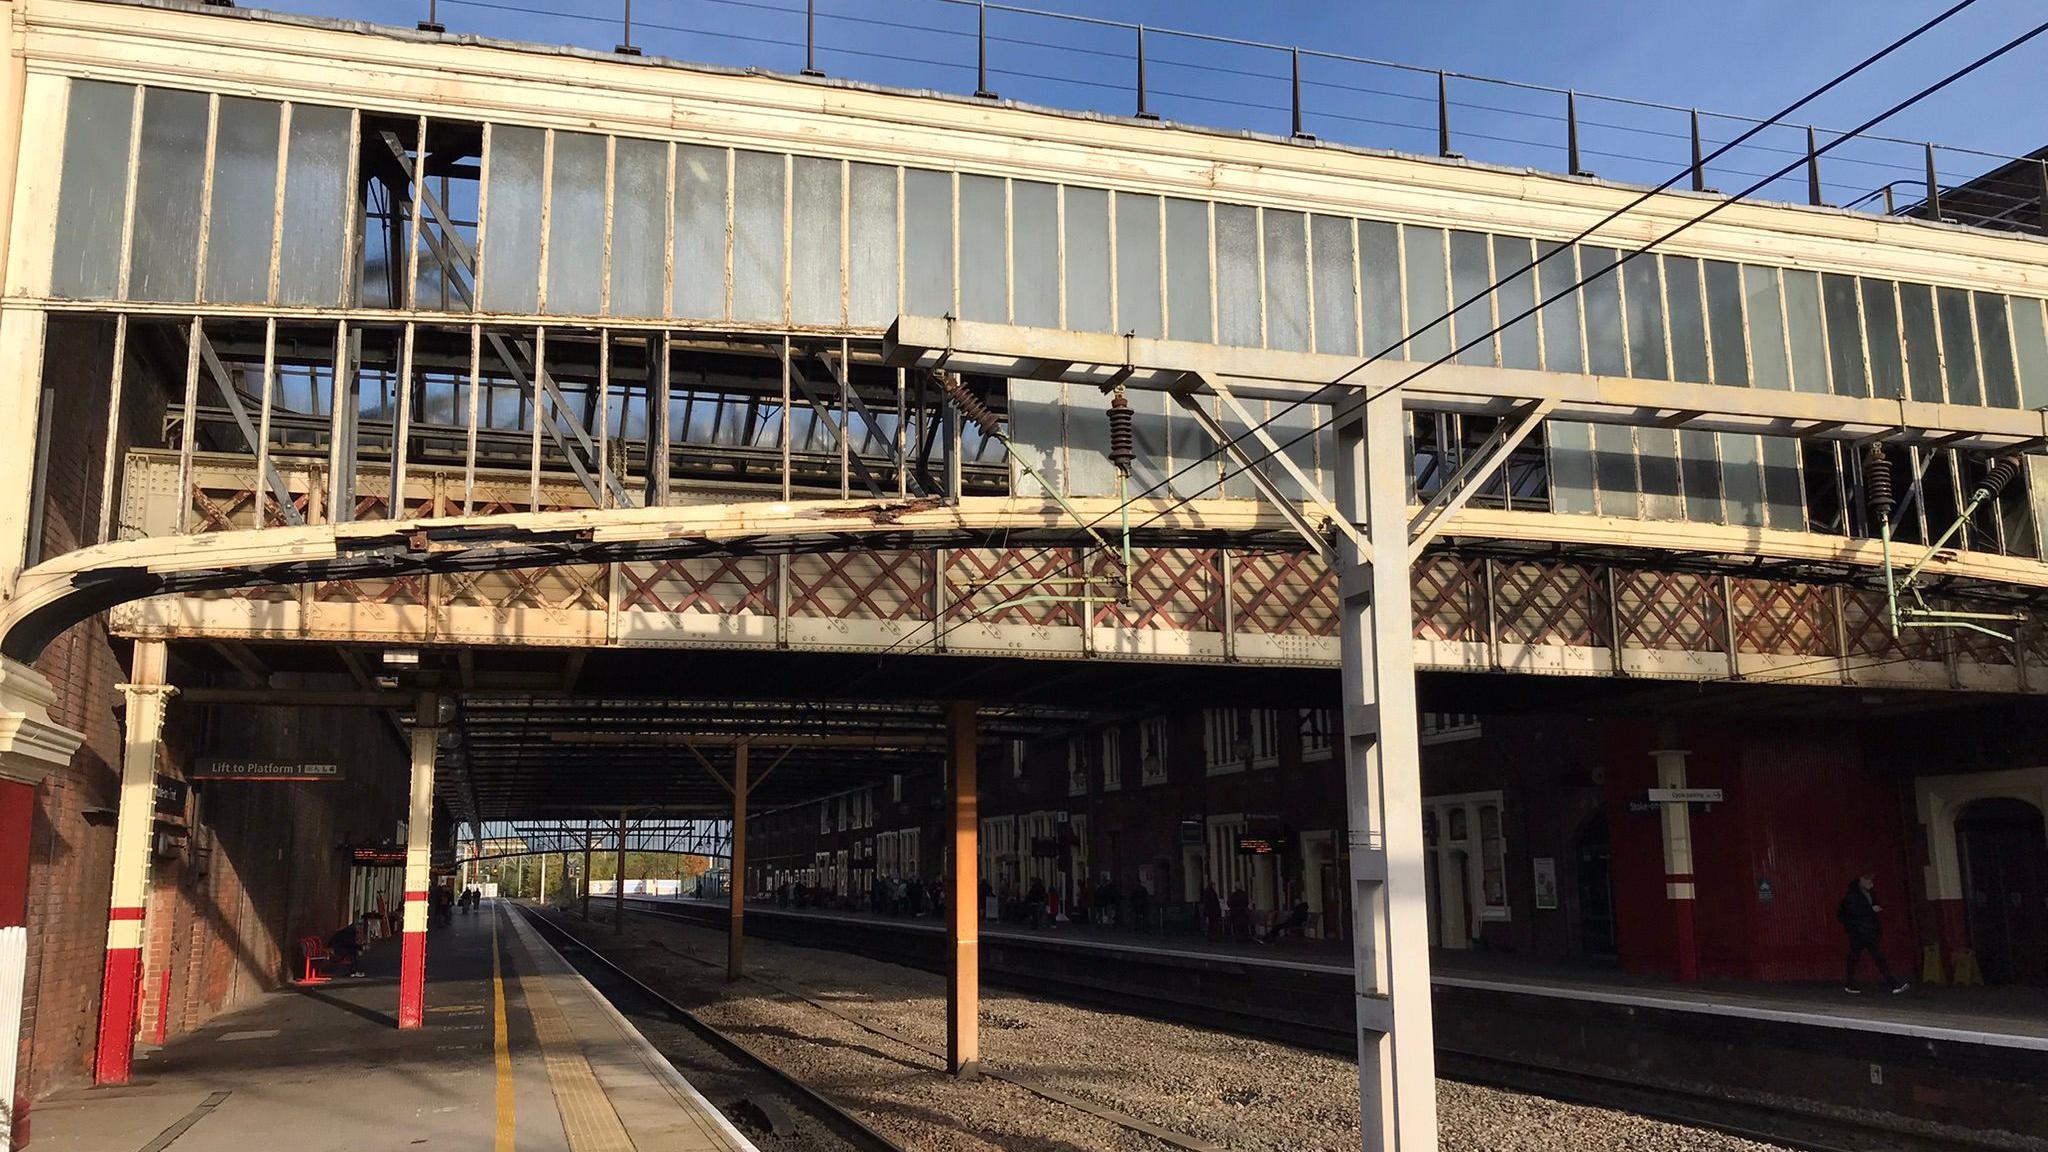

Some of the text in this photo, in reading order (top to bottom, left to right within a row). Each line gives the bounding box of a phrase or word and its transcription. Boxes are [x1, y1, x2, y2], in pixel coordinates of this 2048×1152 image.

[212, 763, 303, 773] Lift to Platform 1
